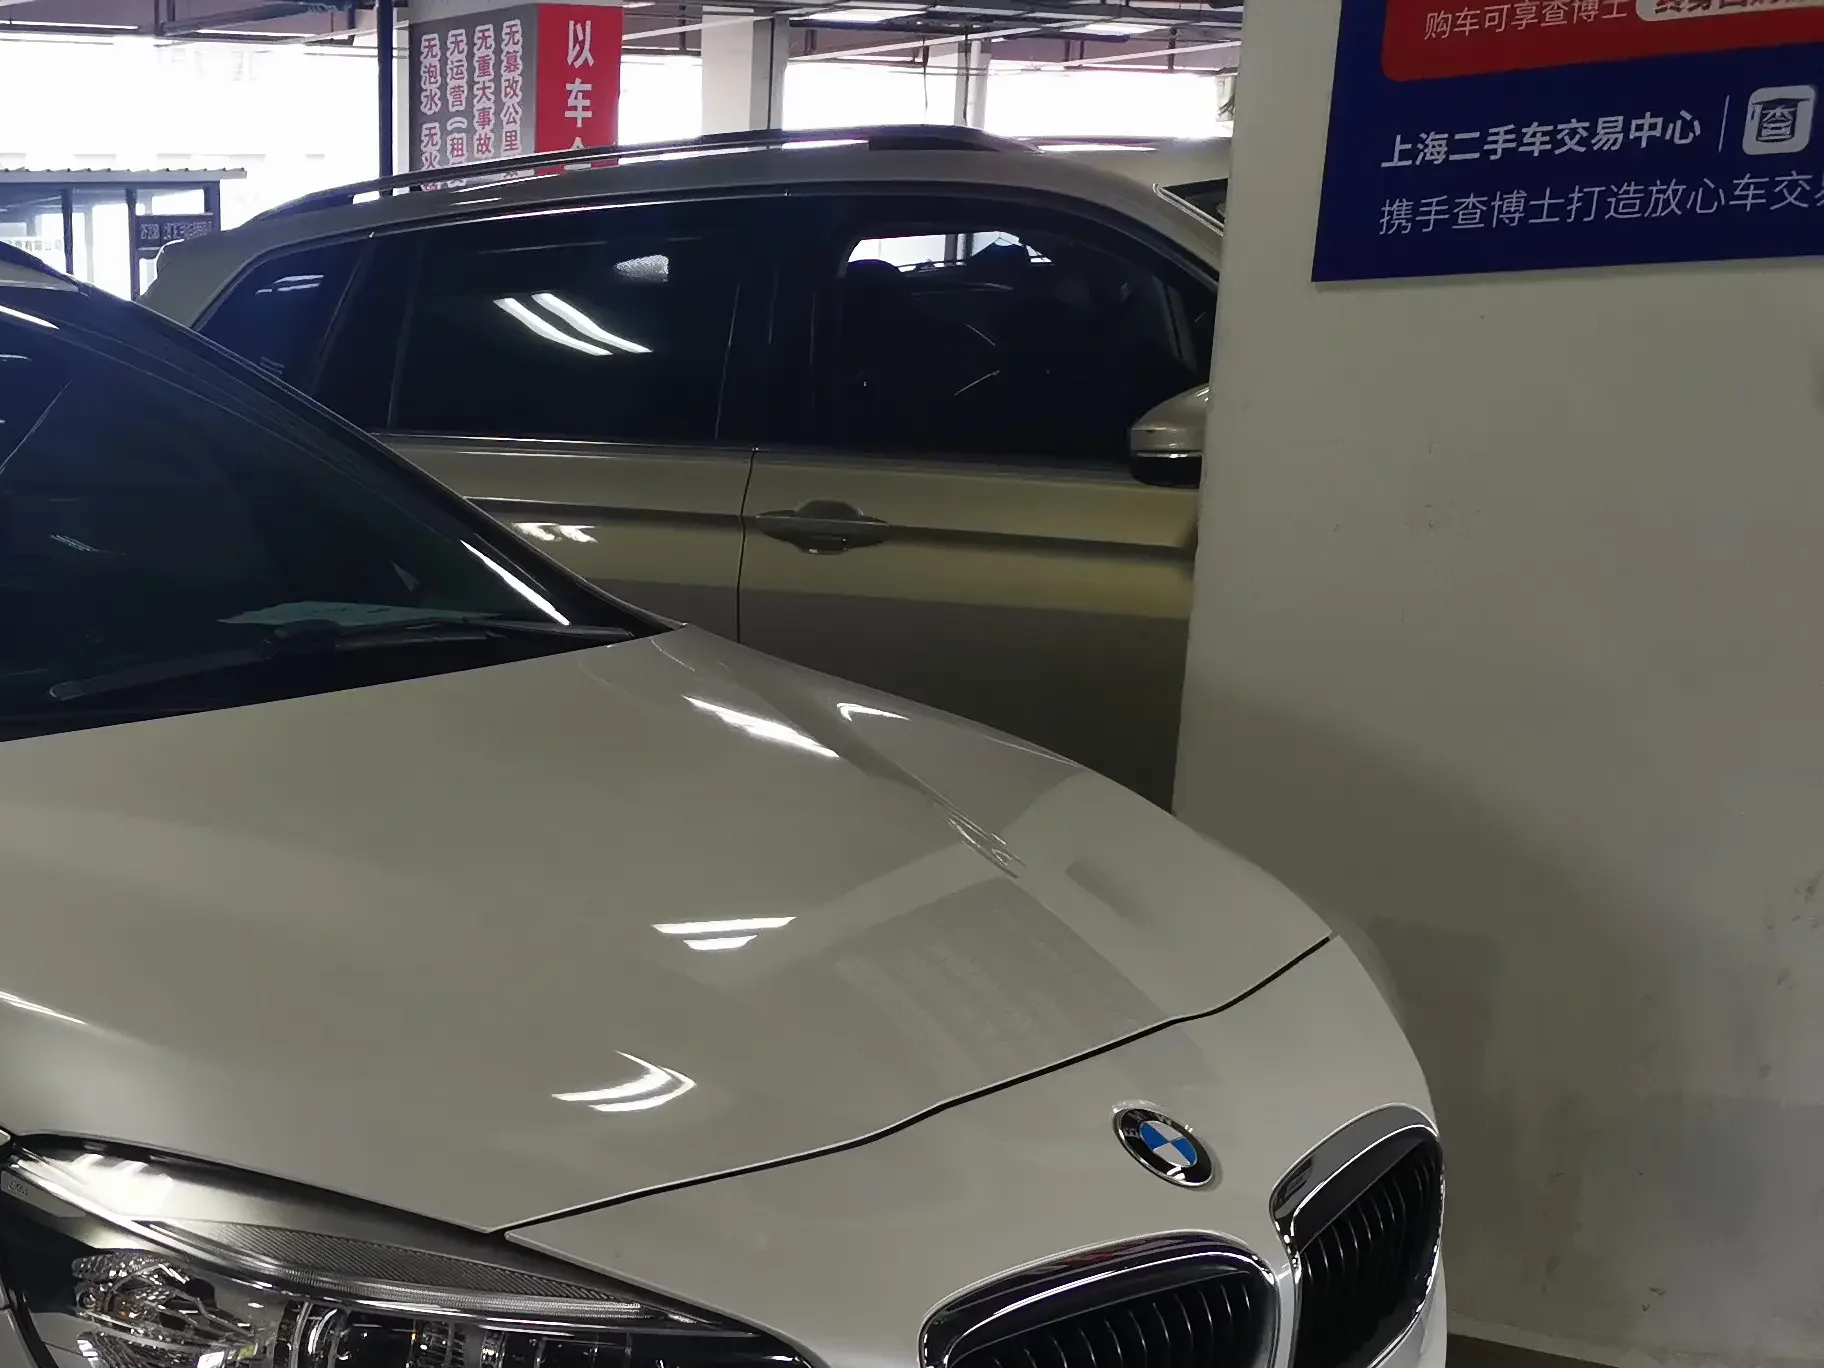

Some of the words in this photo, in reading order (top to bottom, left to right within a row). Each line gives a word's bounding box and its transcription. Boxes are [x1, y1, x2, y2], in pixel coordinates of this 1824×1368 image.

[1424, 0, 1628, 40] 购车可享查博士
[421, 34, 440, 114] 无泡水
[474, 24, 494, 158] 无重大事故
[565, 20, 594, 150] 以车
[421, 123, 440, 191] 无火
[1380, 109, 1701, 168] 上海二手车交易中心
